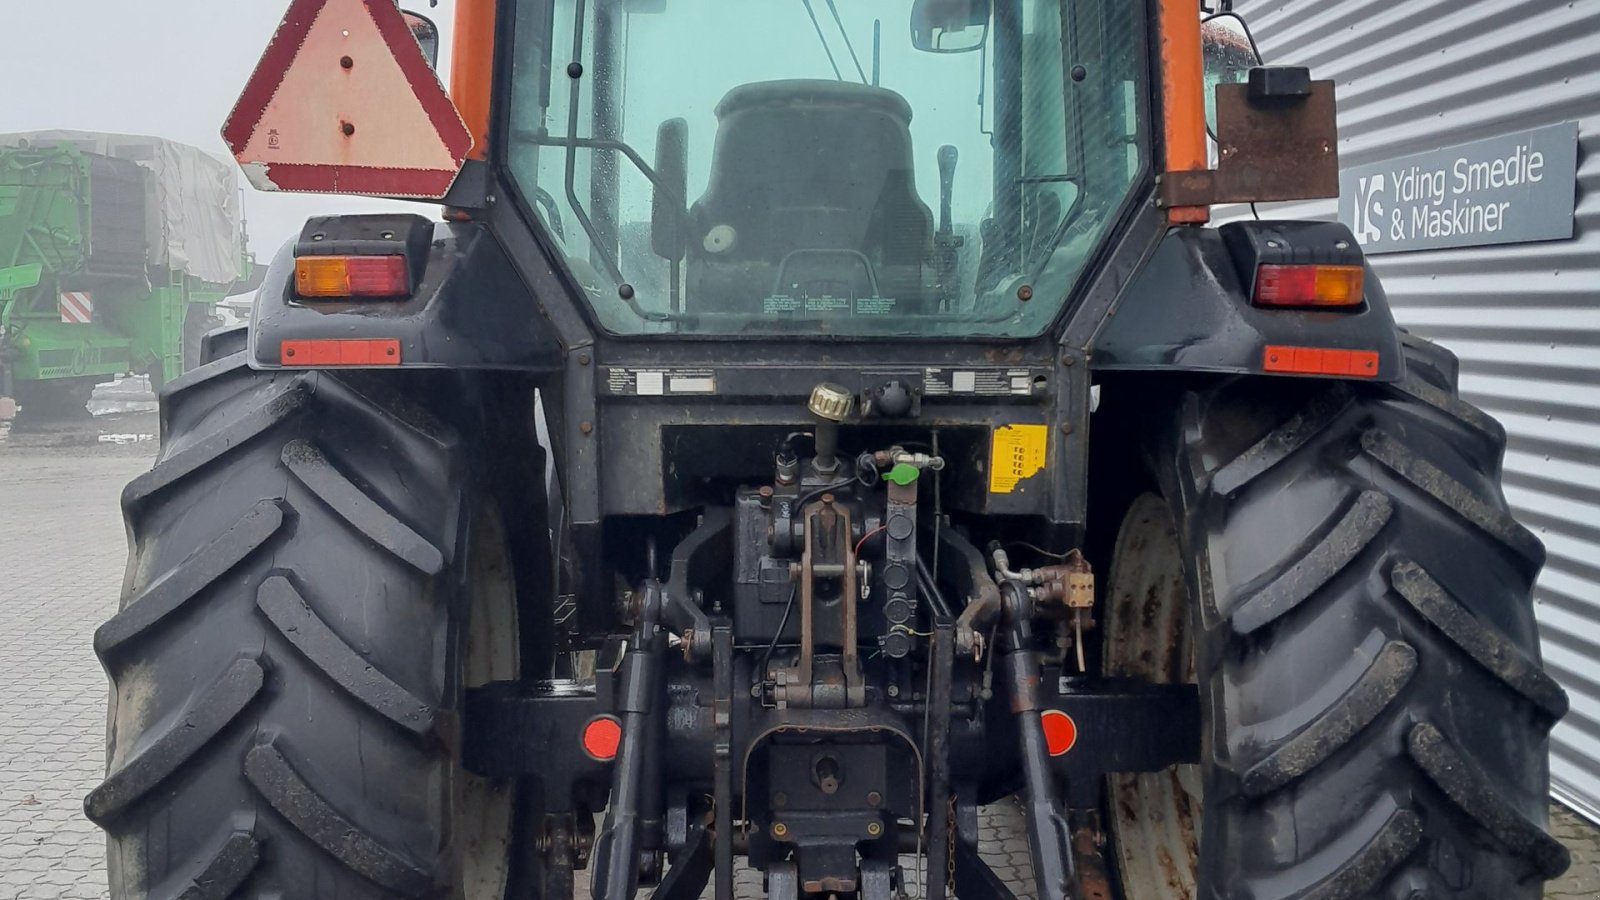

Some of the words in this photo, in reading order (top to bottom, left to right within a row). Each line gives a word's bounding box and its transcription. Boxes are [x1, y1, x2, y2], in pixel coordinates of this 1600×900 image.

[1392, 167, 1446, 206] Yding
[1453, 145, 1545, 194] Smedie
[1391, 207, 1406, 240] &
[1412, 199, 1511, 239] Maskiner
